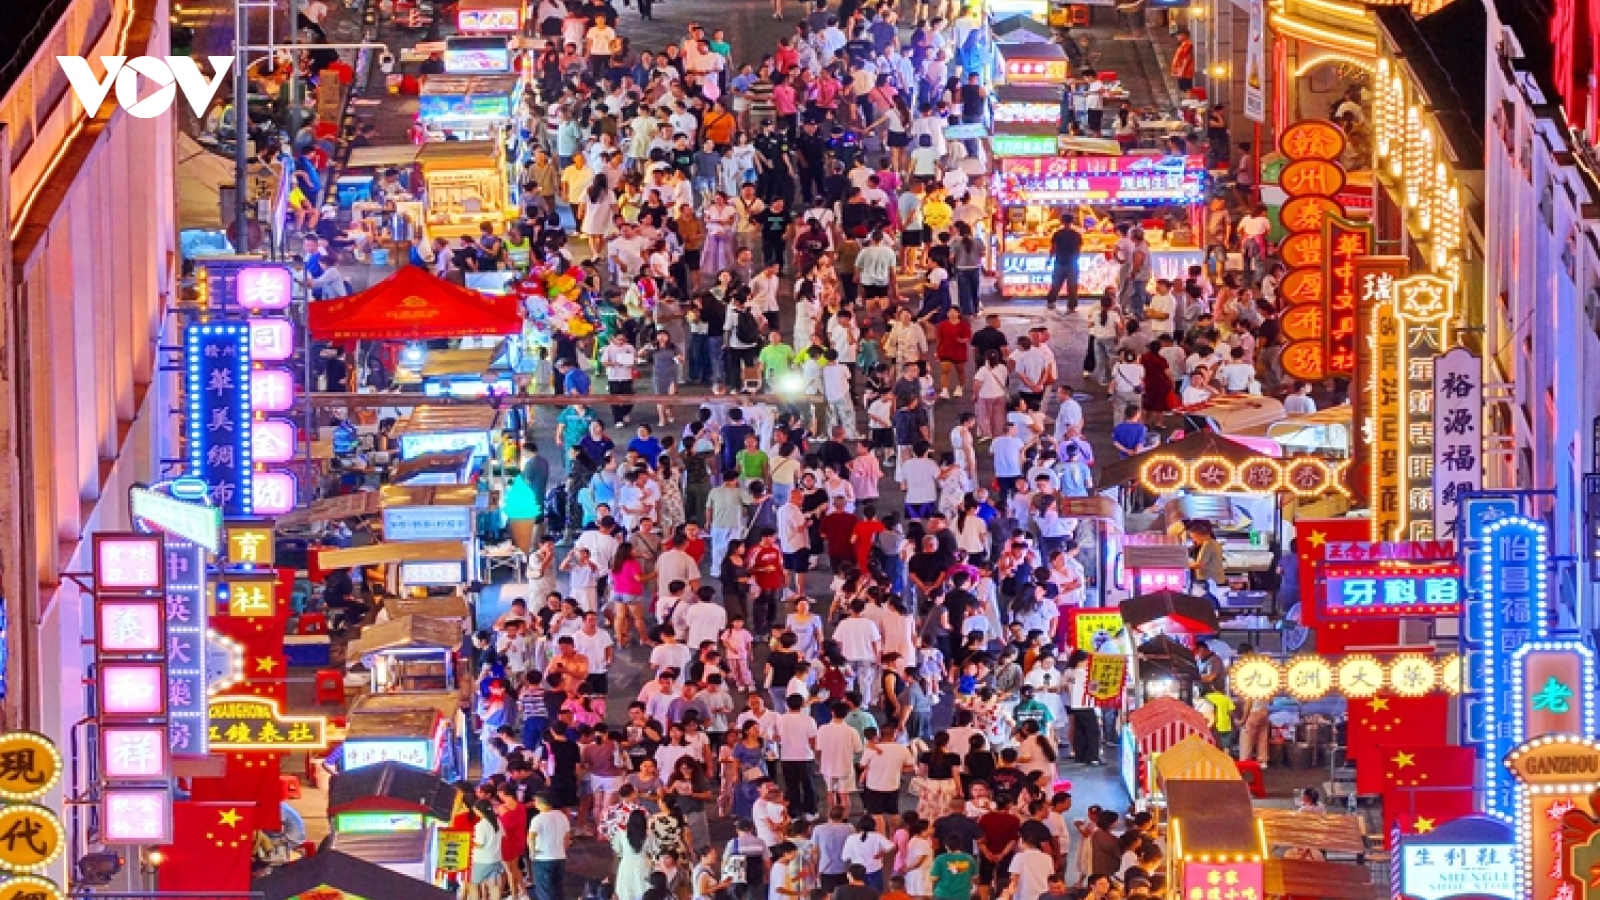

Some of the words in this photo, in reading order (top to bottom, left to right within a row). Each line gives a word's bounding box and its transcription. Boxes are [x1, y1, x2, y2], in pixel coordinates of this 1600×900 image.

[1152, 464, 1346, 487] 仙女牌香
[1243, 665, 1459, 689] 九洲大藥
[1532, 676, 1573, 713] 老
[1525, 755, 1598, 774] GANZHOU
